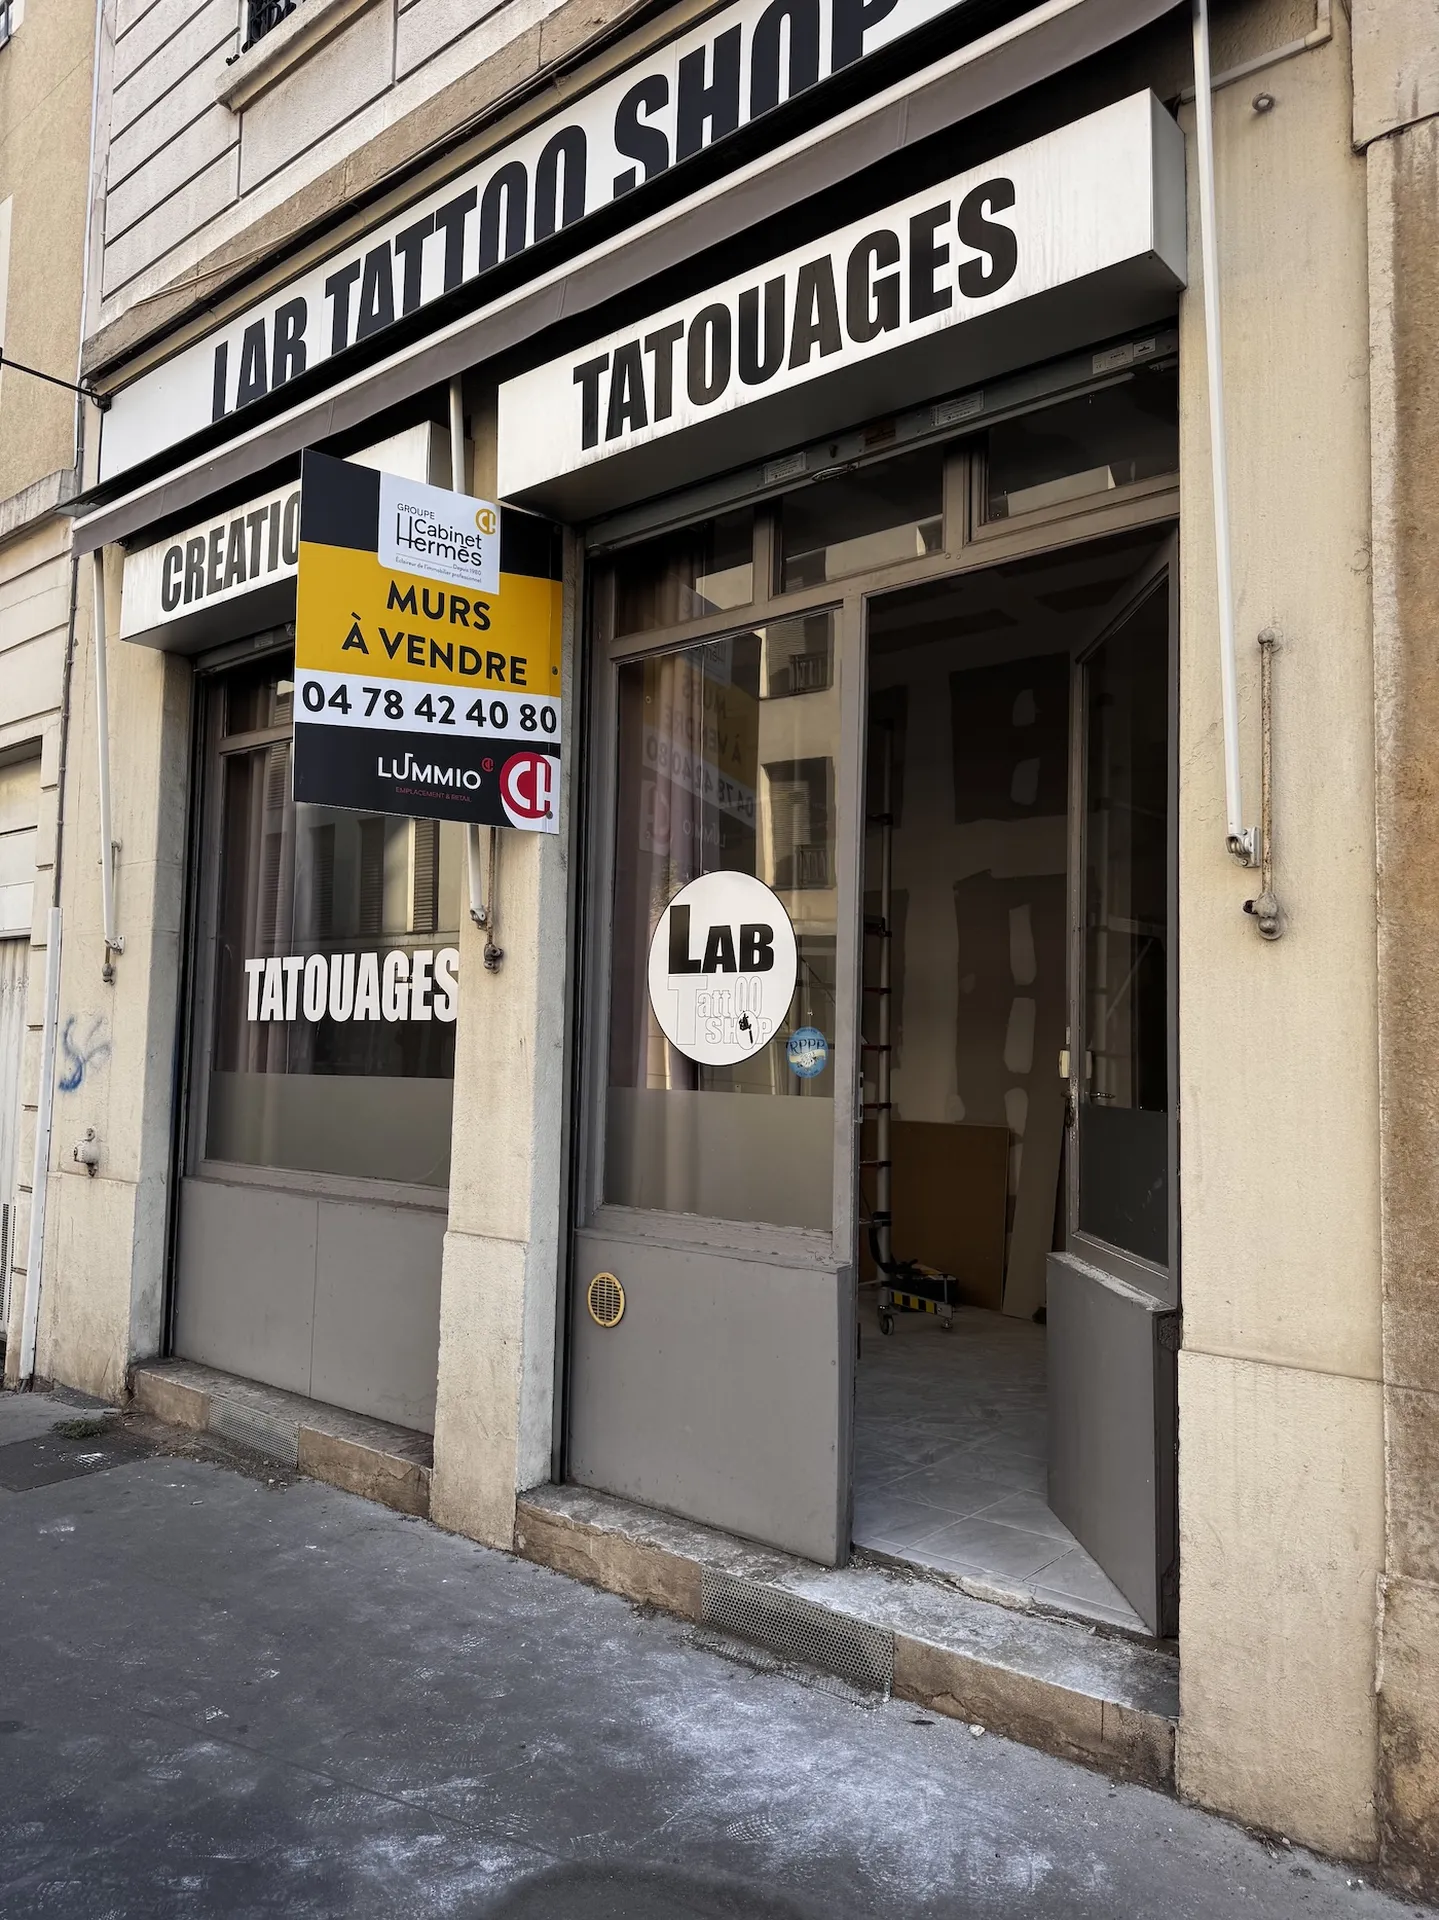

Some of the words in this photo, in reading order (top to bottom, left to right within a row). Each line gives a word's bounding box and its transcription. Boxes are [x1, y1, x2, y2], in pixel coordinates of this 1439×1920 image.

[325, 125, 587, 355] TATTOO
[573, 177, 1018, 451] TATOUAGES
[397, 503, 435, 520] GROUPE
[414, 519, 482, 550] Cabinet
[451, 571, 482, 583] professionnel
[453, 563, 469, 573] Depuis
[387, 580, 490, 631] MURS
[341, 612, 369, 655] À
[378, 627, 527, 686] VENDRE
[302, 681, 352, 715] 04
[362, 686, 404, 720] 78
[414, 693, 456, 725] 42
[466, 699, 508, 729] 40
[519, 703, 557, 733] 80
[377, 753, 481, 790] LUMMIO
[395, 787, 445, 800] EMPLACEMENT
[451, 794, 472, 803] RETAIL
[668, 904, 774, 974] LAB
[244, 947, 460, 1022] TATOUAGES
[705, 1009, 773, 1050] SHOP
